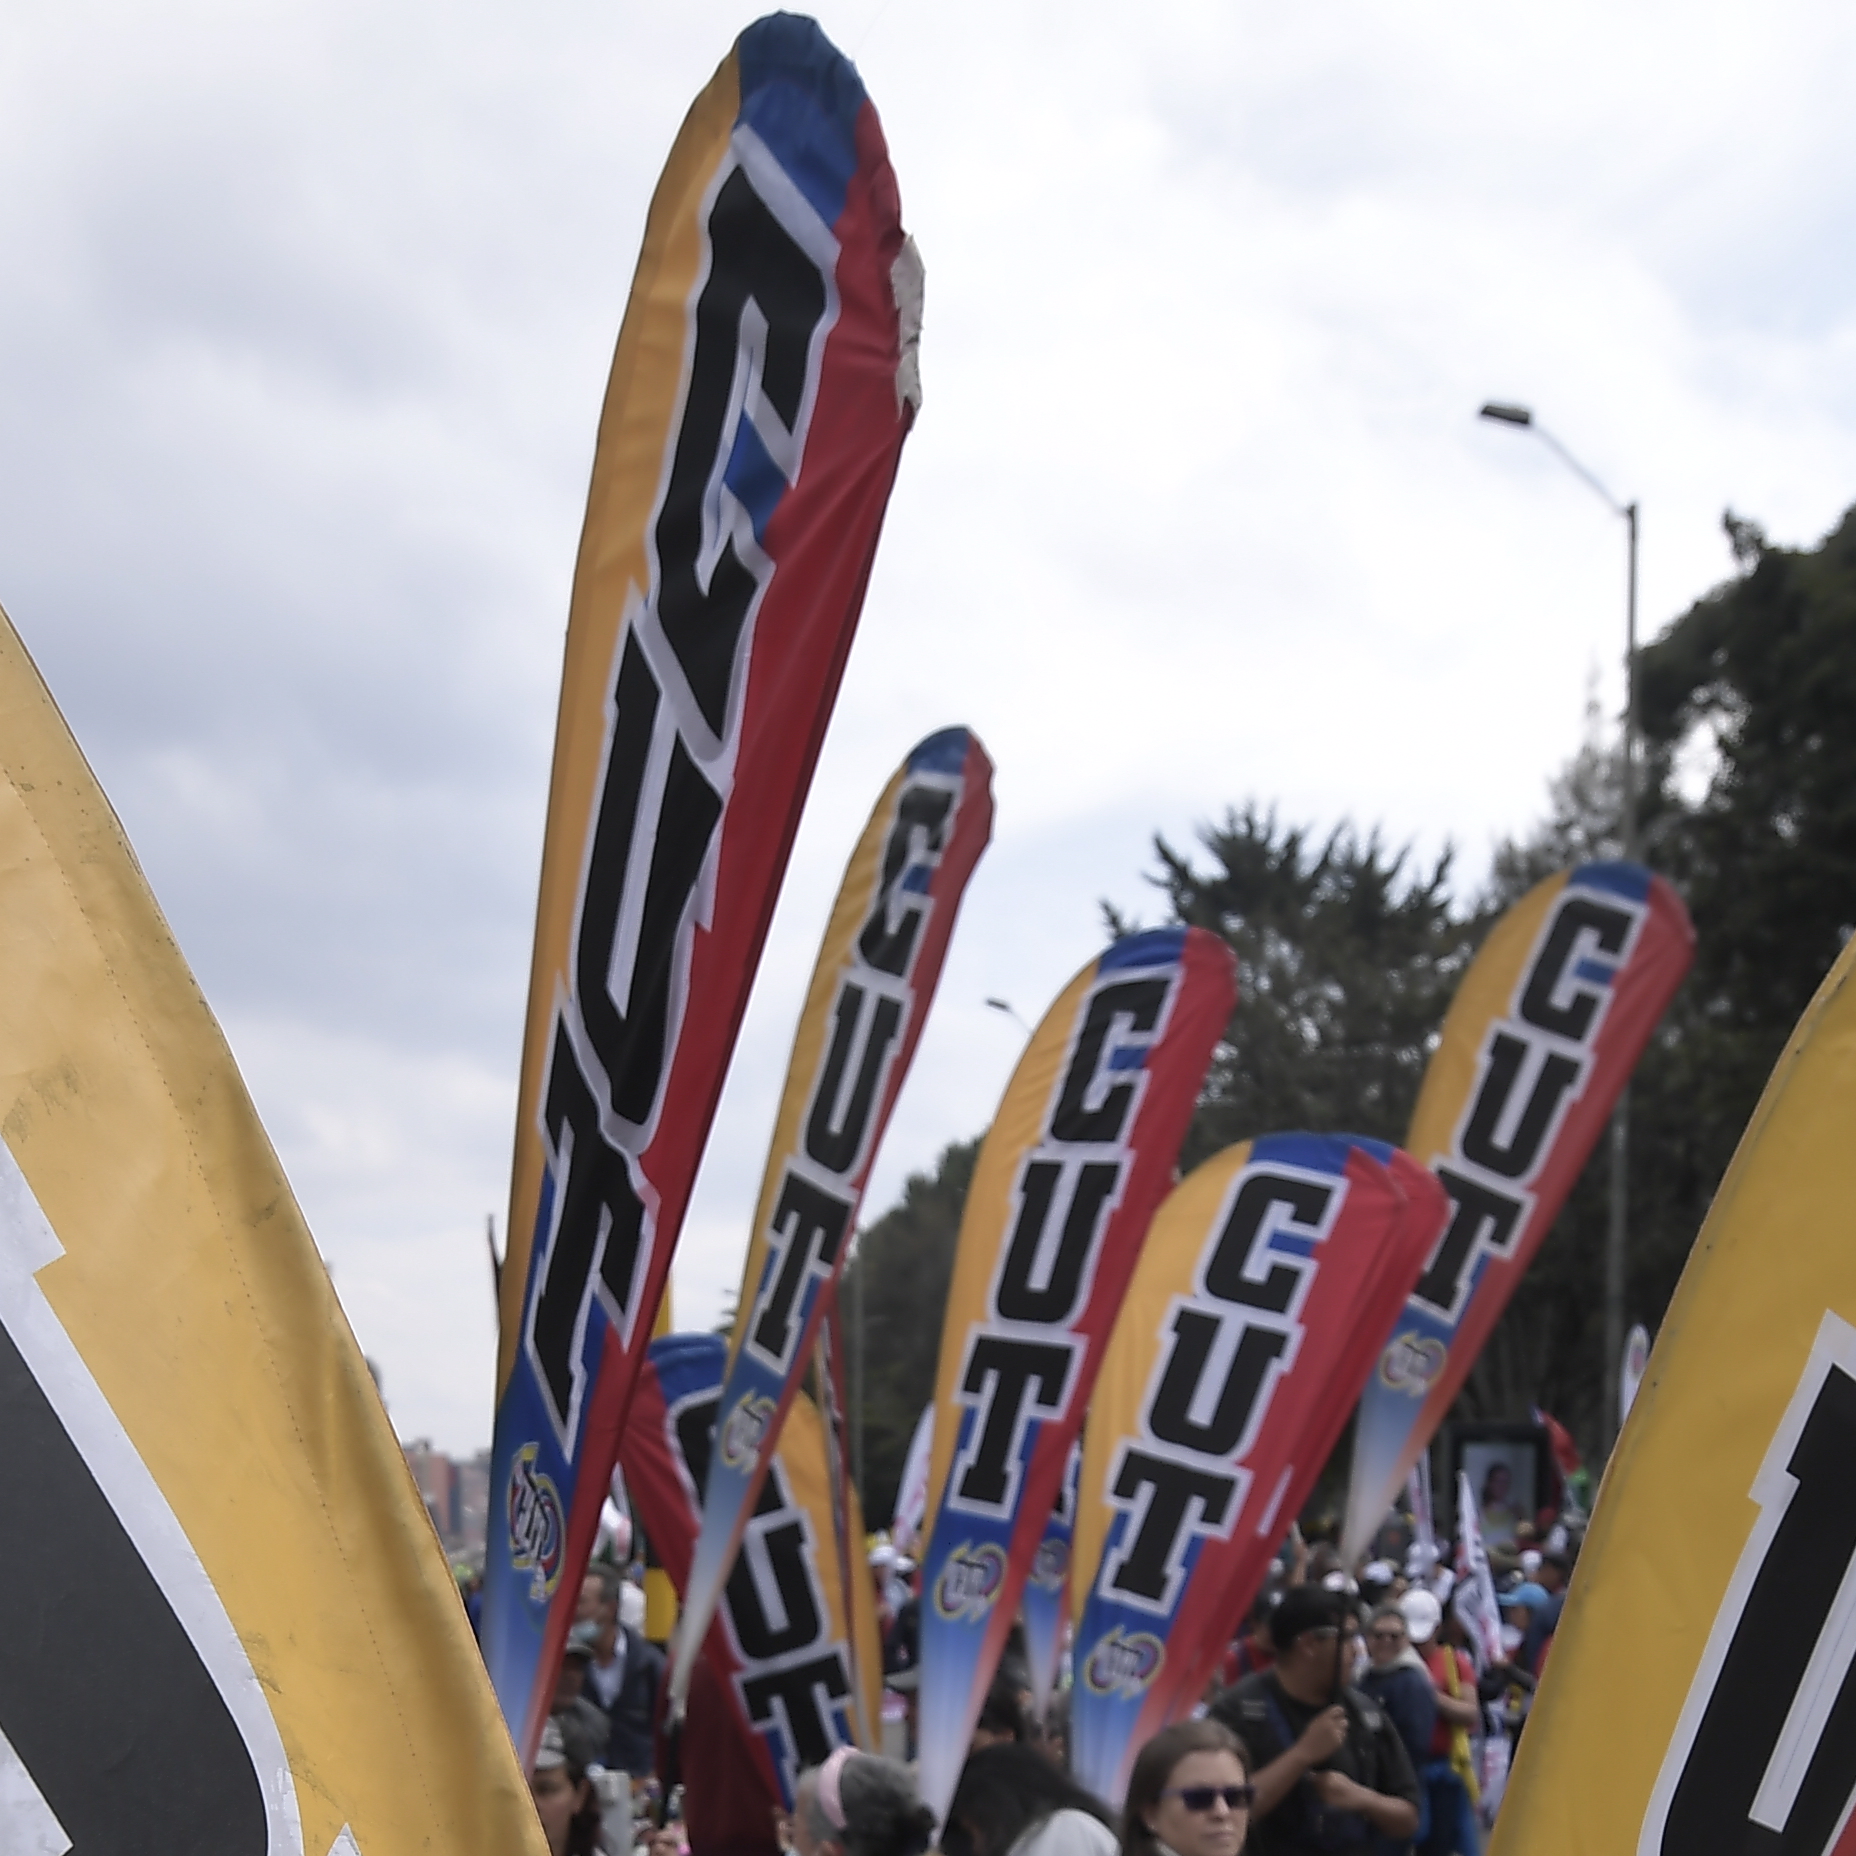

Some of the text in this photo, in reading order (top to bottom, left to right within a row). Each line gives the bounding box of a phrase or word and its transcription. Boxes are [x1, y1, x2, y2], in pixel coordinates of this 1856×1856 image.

[530, 160, 834, 1430] CUT
[749, 783, 957, 1361] CUT
[956, 972, 1178, 1506] CUT
[1412, 892, 1638, 1314] CUT
[1109, 1172, 1338, 1602] CUT
